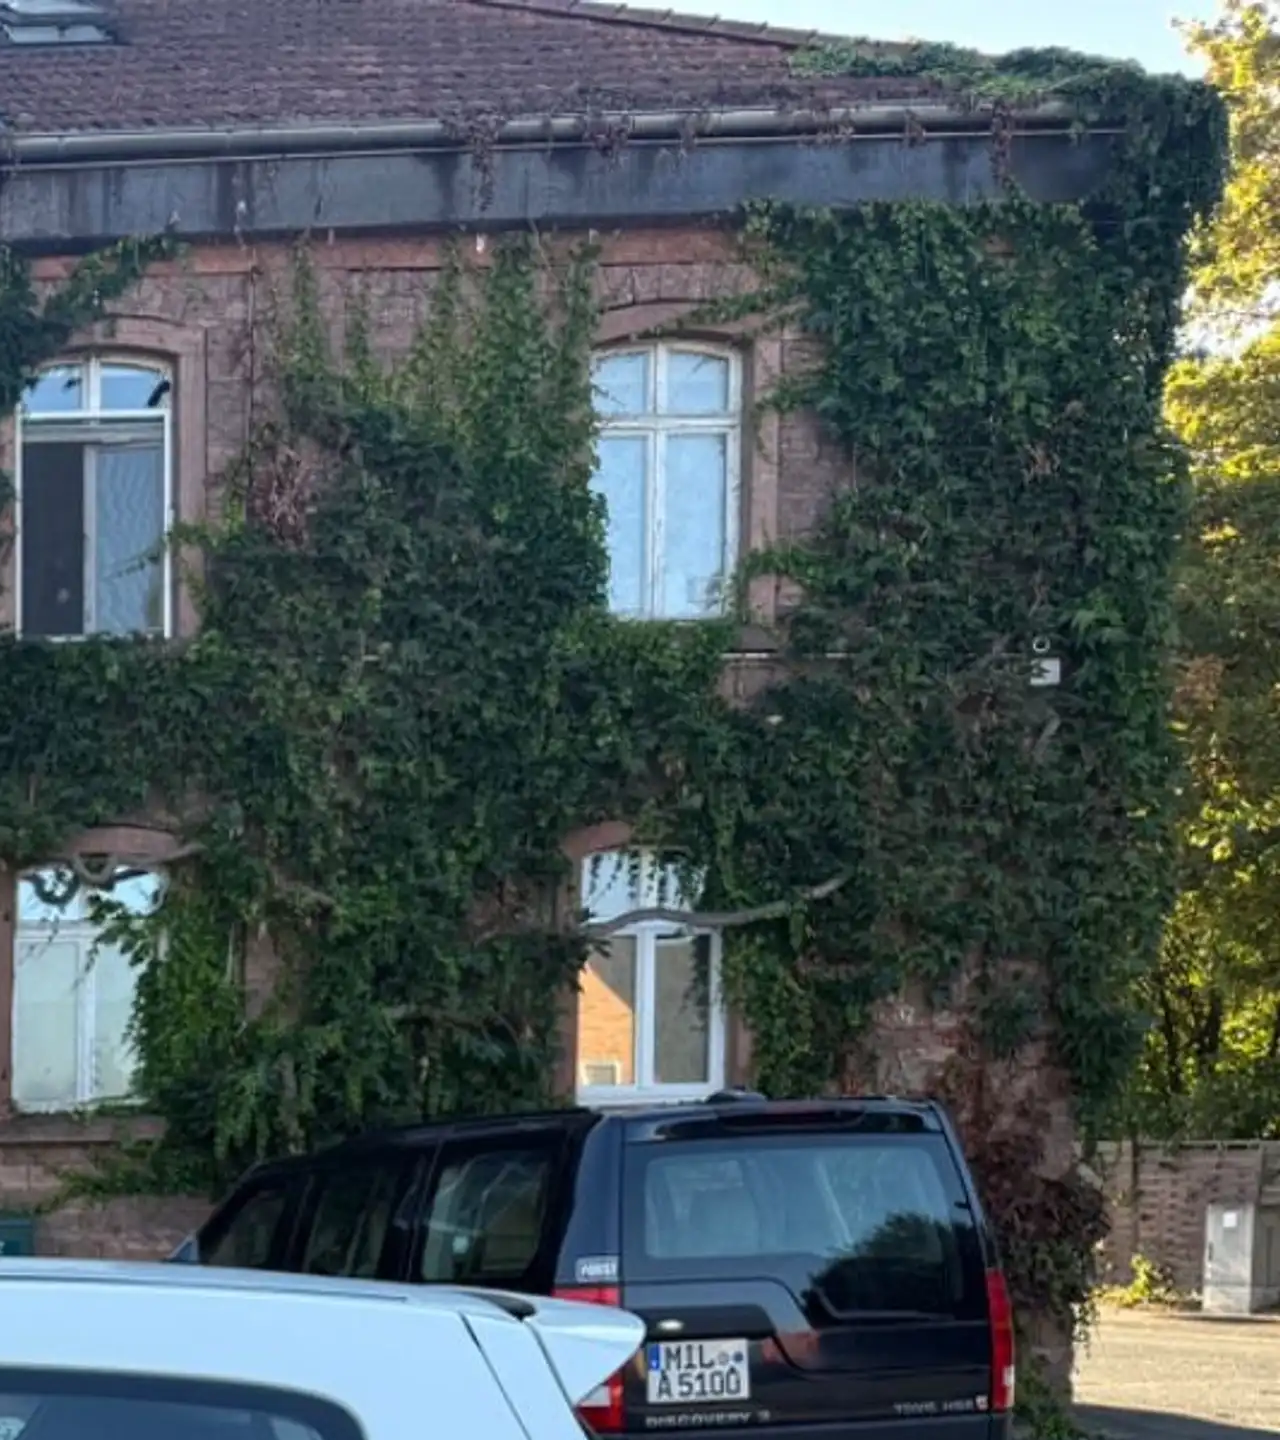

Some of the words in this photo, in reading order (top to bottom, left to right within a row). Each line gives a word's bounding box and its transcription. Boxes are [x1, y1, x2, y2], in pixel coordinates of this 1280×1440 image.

[665, 1344, 715, 1371] MIL
[657, 1369, 672, 1398] A
[677, 1370, 741, 1398] 5100
